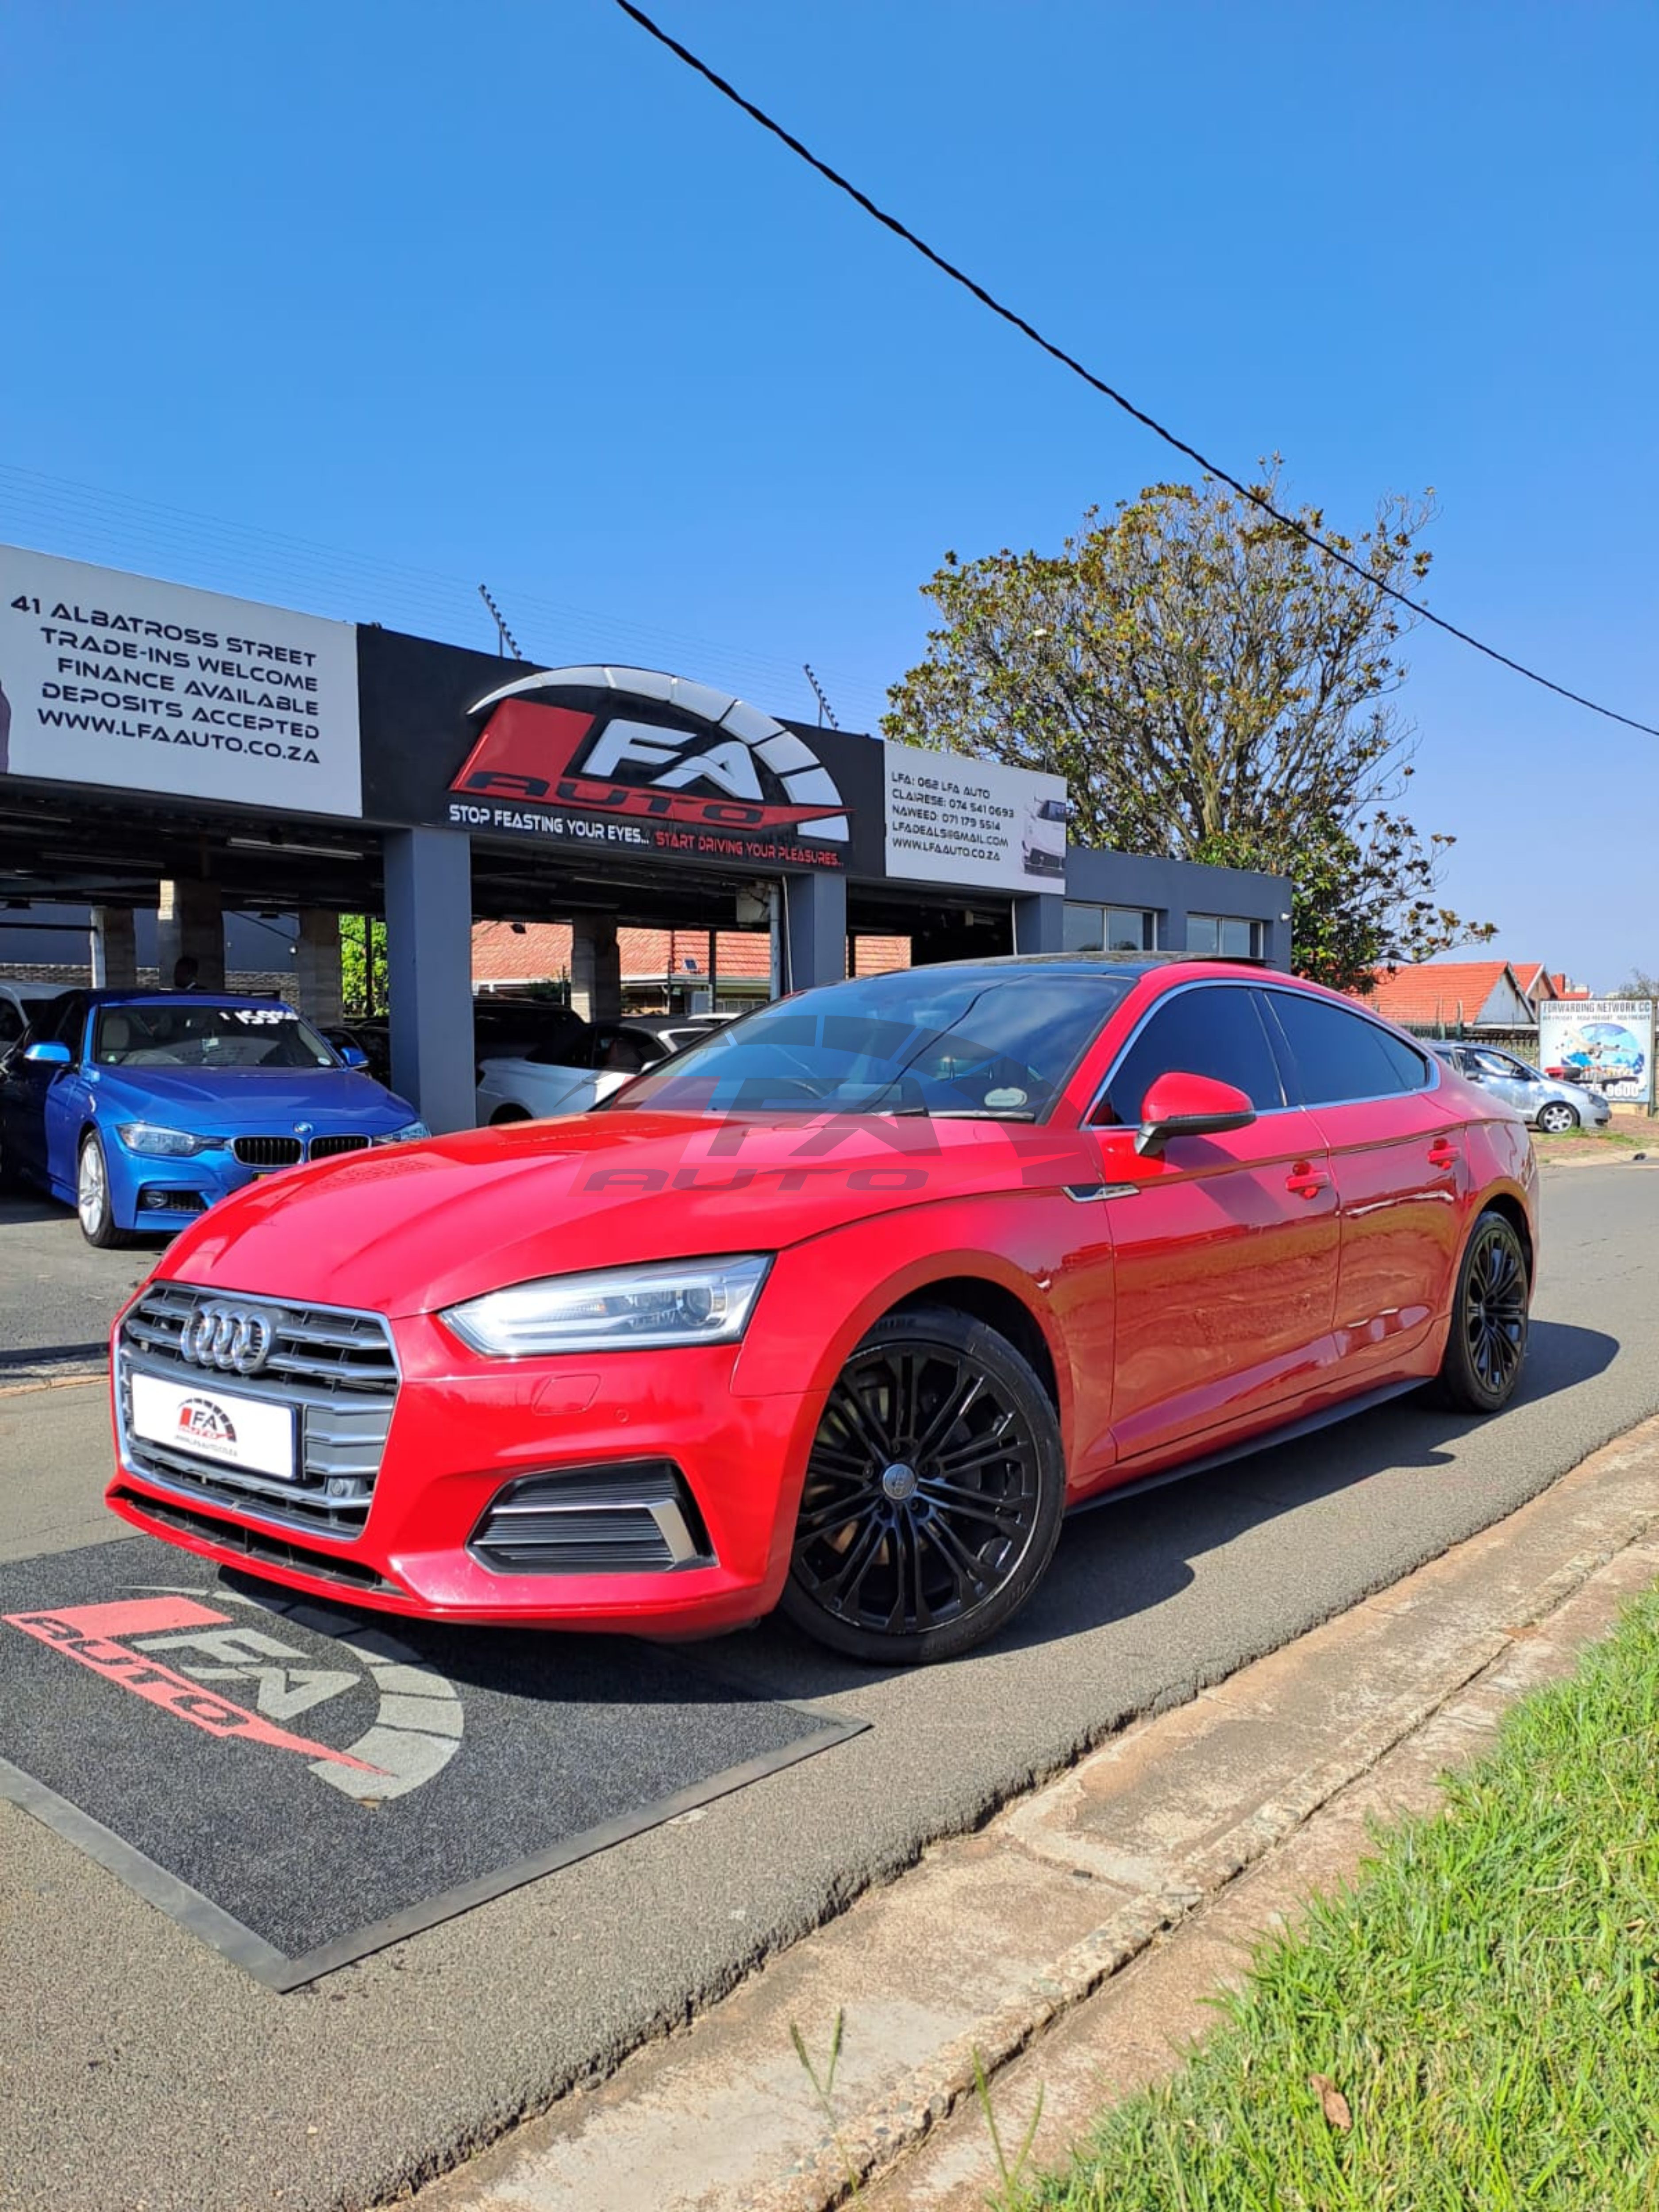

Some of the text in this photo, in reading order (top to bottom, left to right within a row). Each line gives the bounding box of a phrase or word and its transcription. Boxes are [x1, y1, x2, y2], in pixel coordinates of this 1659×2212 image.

[11, 595, 317, 667] 41 ALBATROSS STREET
[40, 627, 318, 692] TRADE-INS WELCOME
[58, 658, 319, 716] FINANCE AVAILABLE
[42, 682, 319, 739] DEPOSITS ACCEPTED
[38, 708, 320, 764] WWW.LFAAUTO.CO.ZA
[466, 771, 764, 823] AUTO
[892, 772, 990, 799] LFA: 062 LFA AUTO
[949, 799, 967, 810] 074
[970, 803, 986, 813] 541
[449, 804, 649, 844] STOP FEASTING YOUR EYES...
[655, 831, 695, 849] START
[698, 835, 743, 856] DRIVING
[746, 842, 776, 858] YOUR
[942, 813, 958, 824] 071
[979, 819, 1001, 831] 5514
[893, 838, 1001, 861] WWW.LFAAUTO.CO.ZA
[1543, 1001, 1651, 1012] FORWARDING NETWORK CC
[20, 1616, 250, 1728] AUTO
